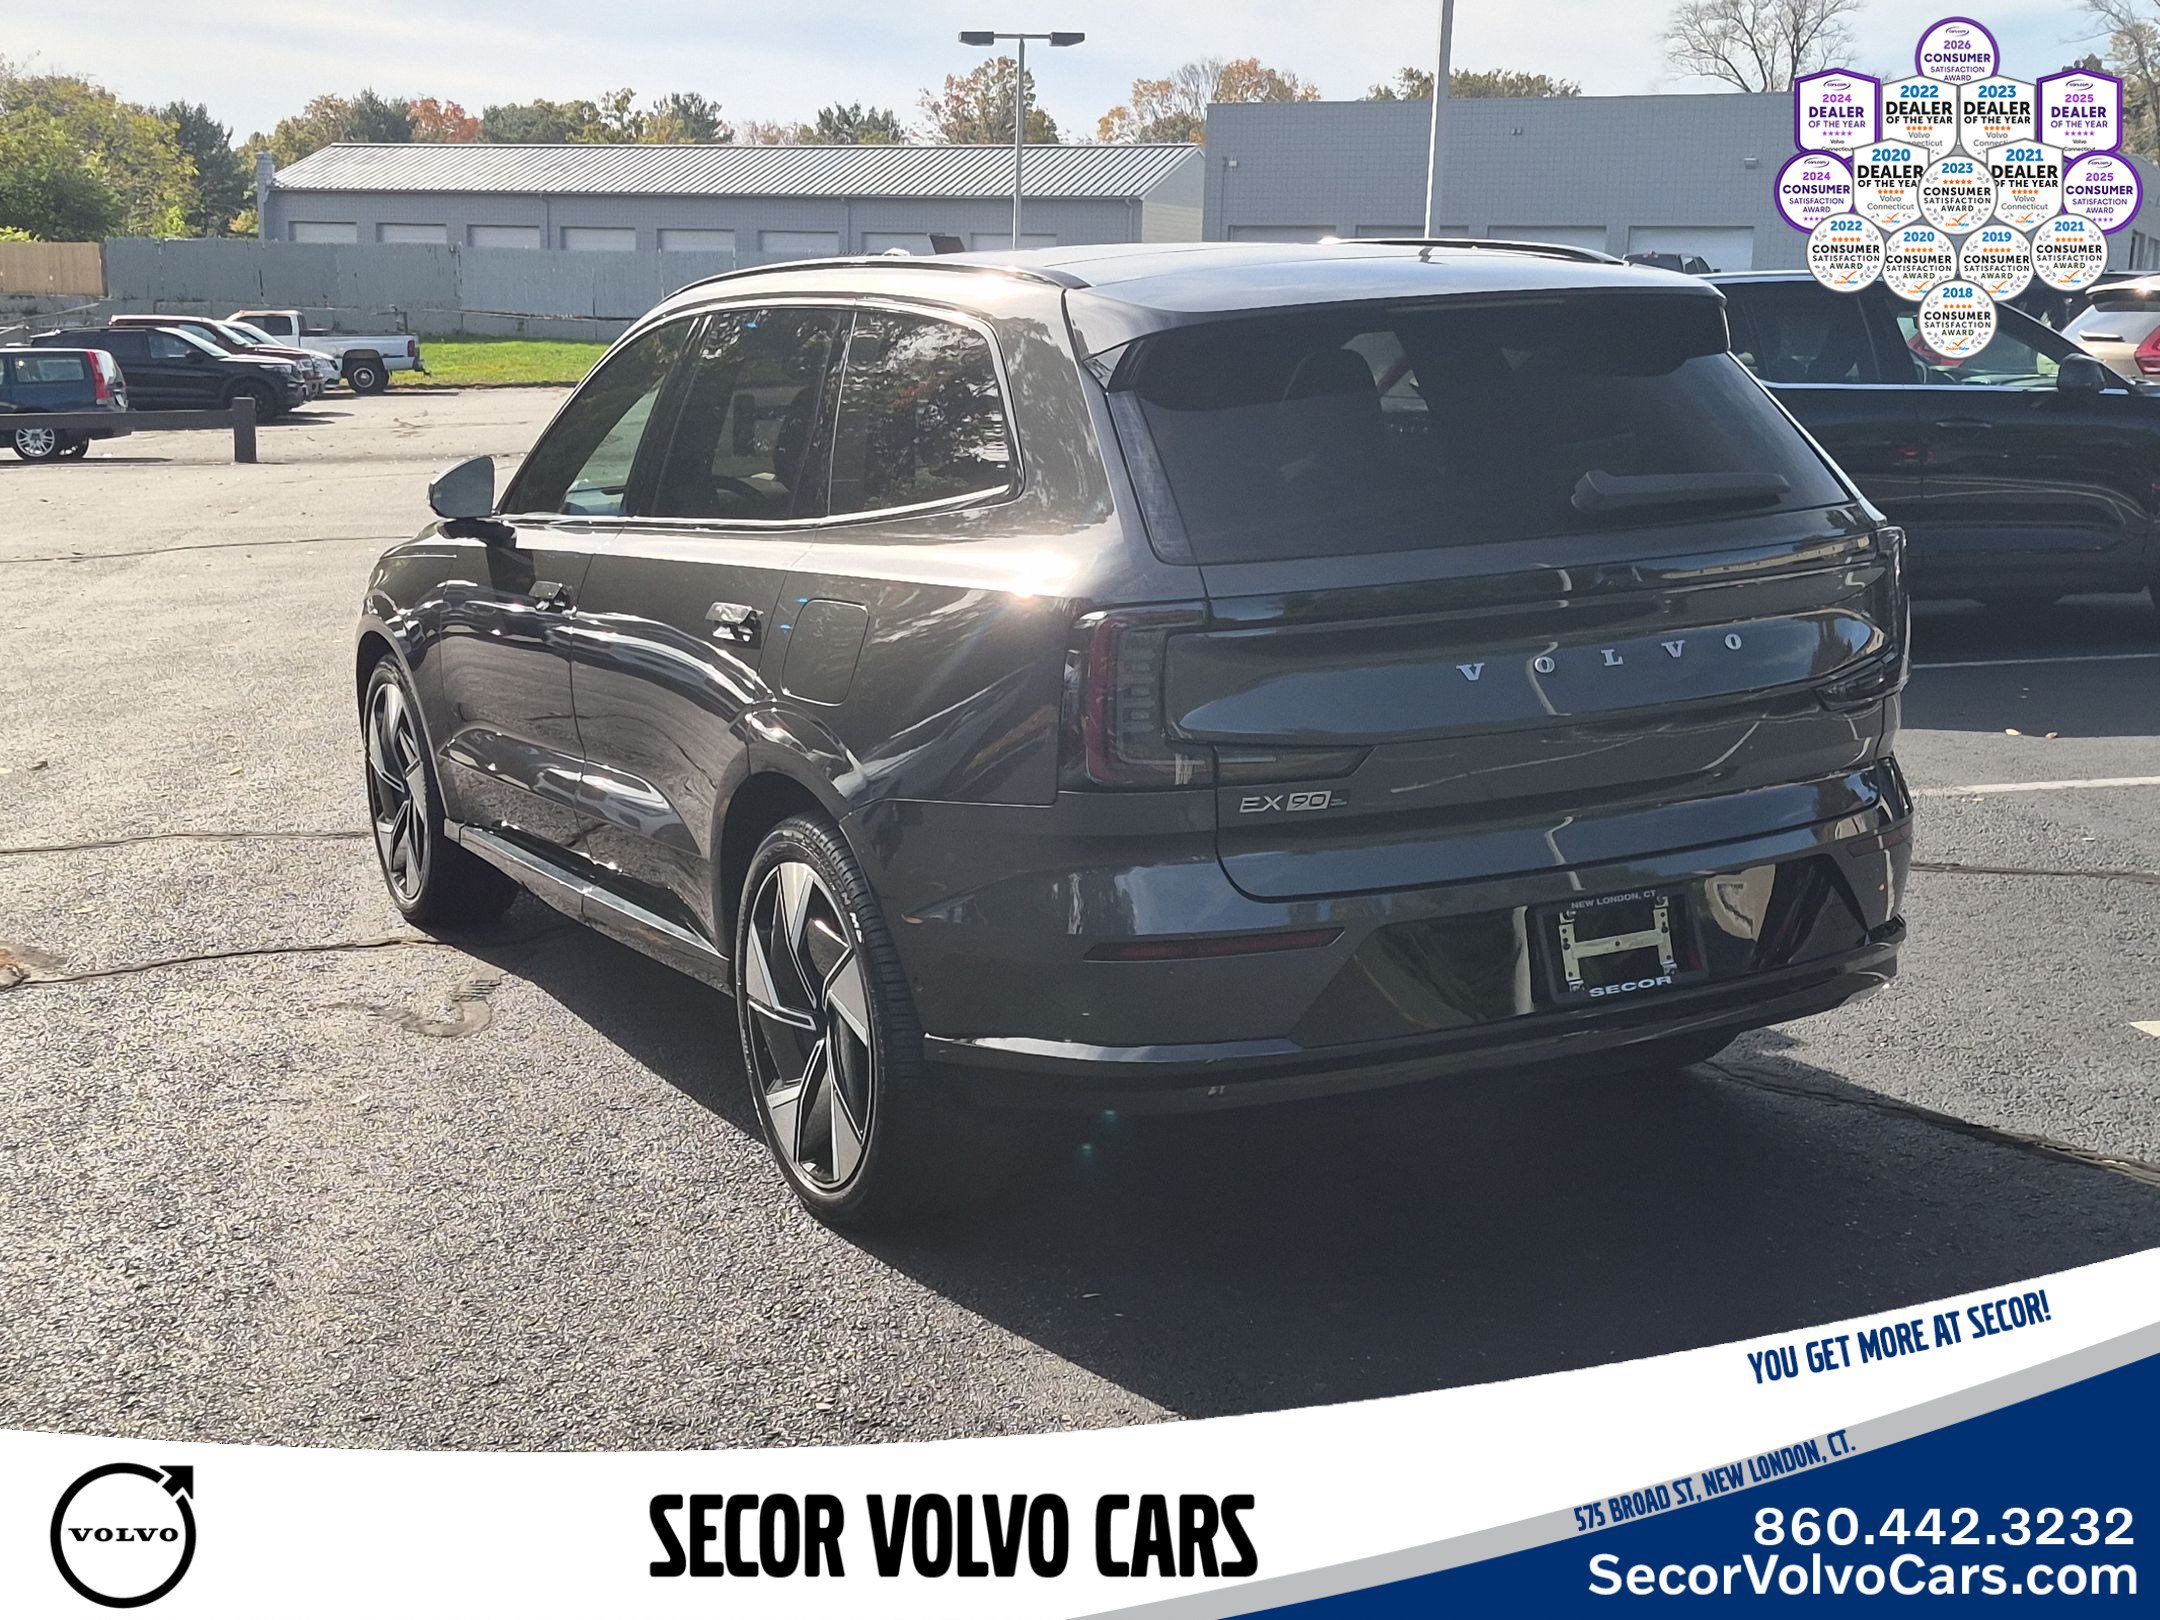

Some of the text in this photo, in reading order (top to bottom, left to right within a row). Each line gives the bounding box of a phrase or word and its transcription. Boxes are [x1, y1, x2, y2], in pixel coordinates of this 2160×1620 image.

[1456, 633, 1742, 681] VOLVO
[1240, 791, 1331, 813] EX90
[1571, 889, 1657, 909] NEW LONDON, CT
[1589, 975, 1673, 997] SECOR
